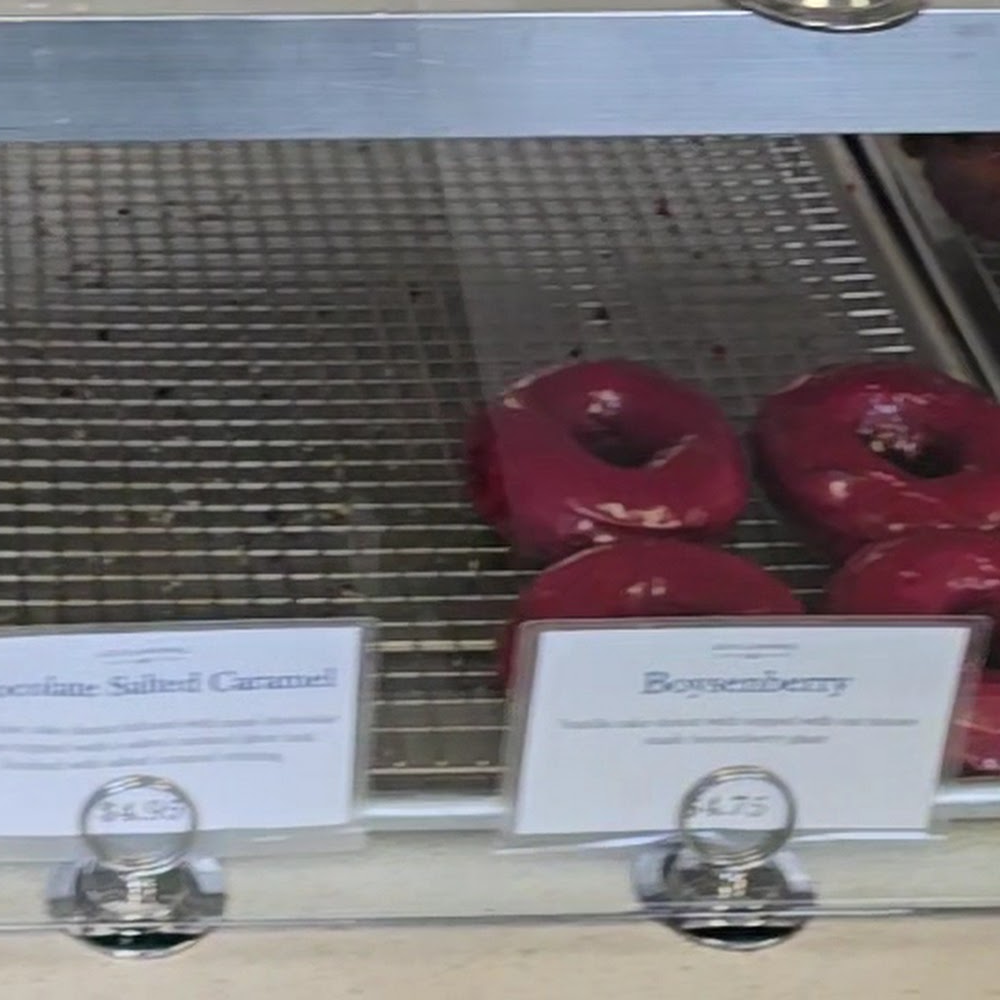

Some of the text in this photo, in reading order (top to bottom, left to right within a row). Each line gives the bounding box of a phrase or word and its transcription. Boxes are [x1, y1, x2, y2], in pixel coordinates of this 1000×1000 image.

[106, 673, 202, 697] Salted
[208, 668, 337, 693] Caramel
[641, 671, 853, 697] Boysenberry
